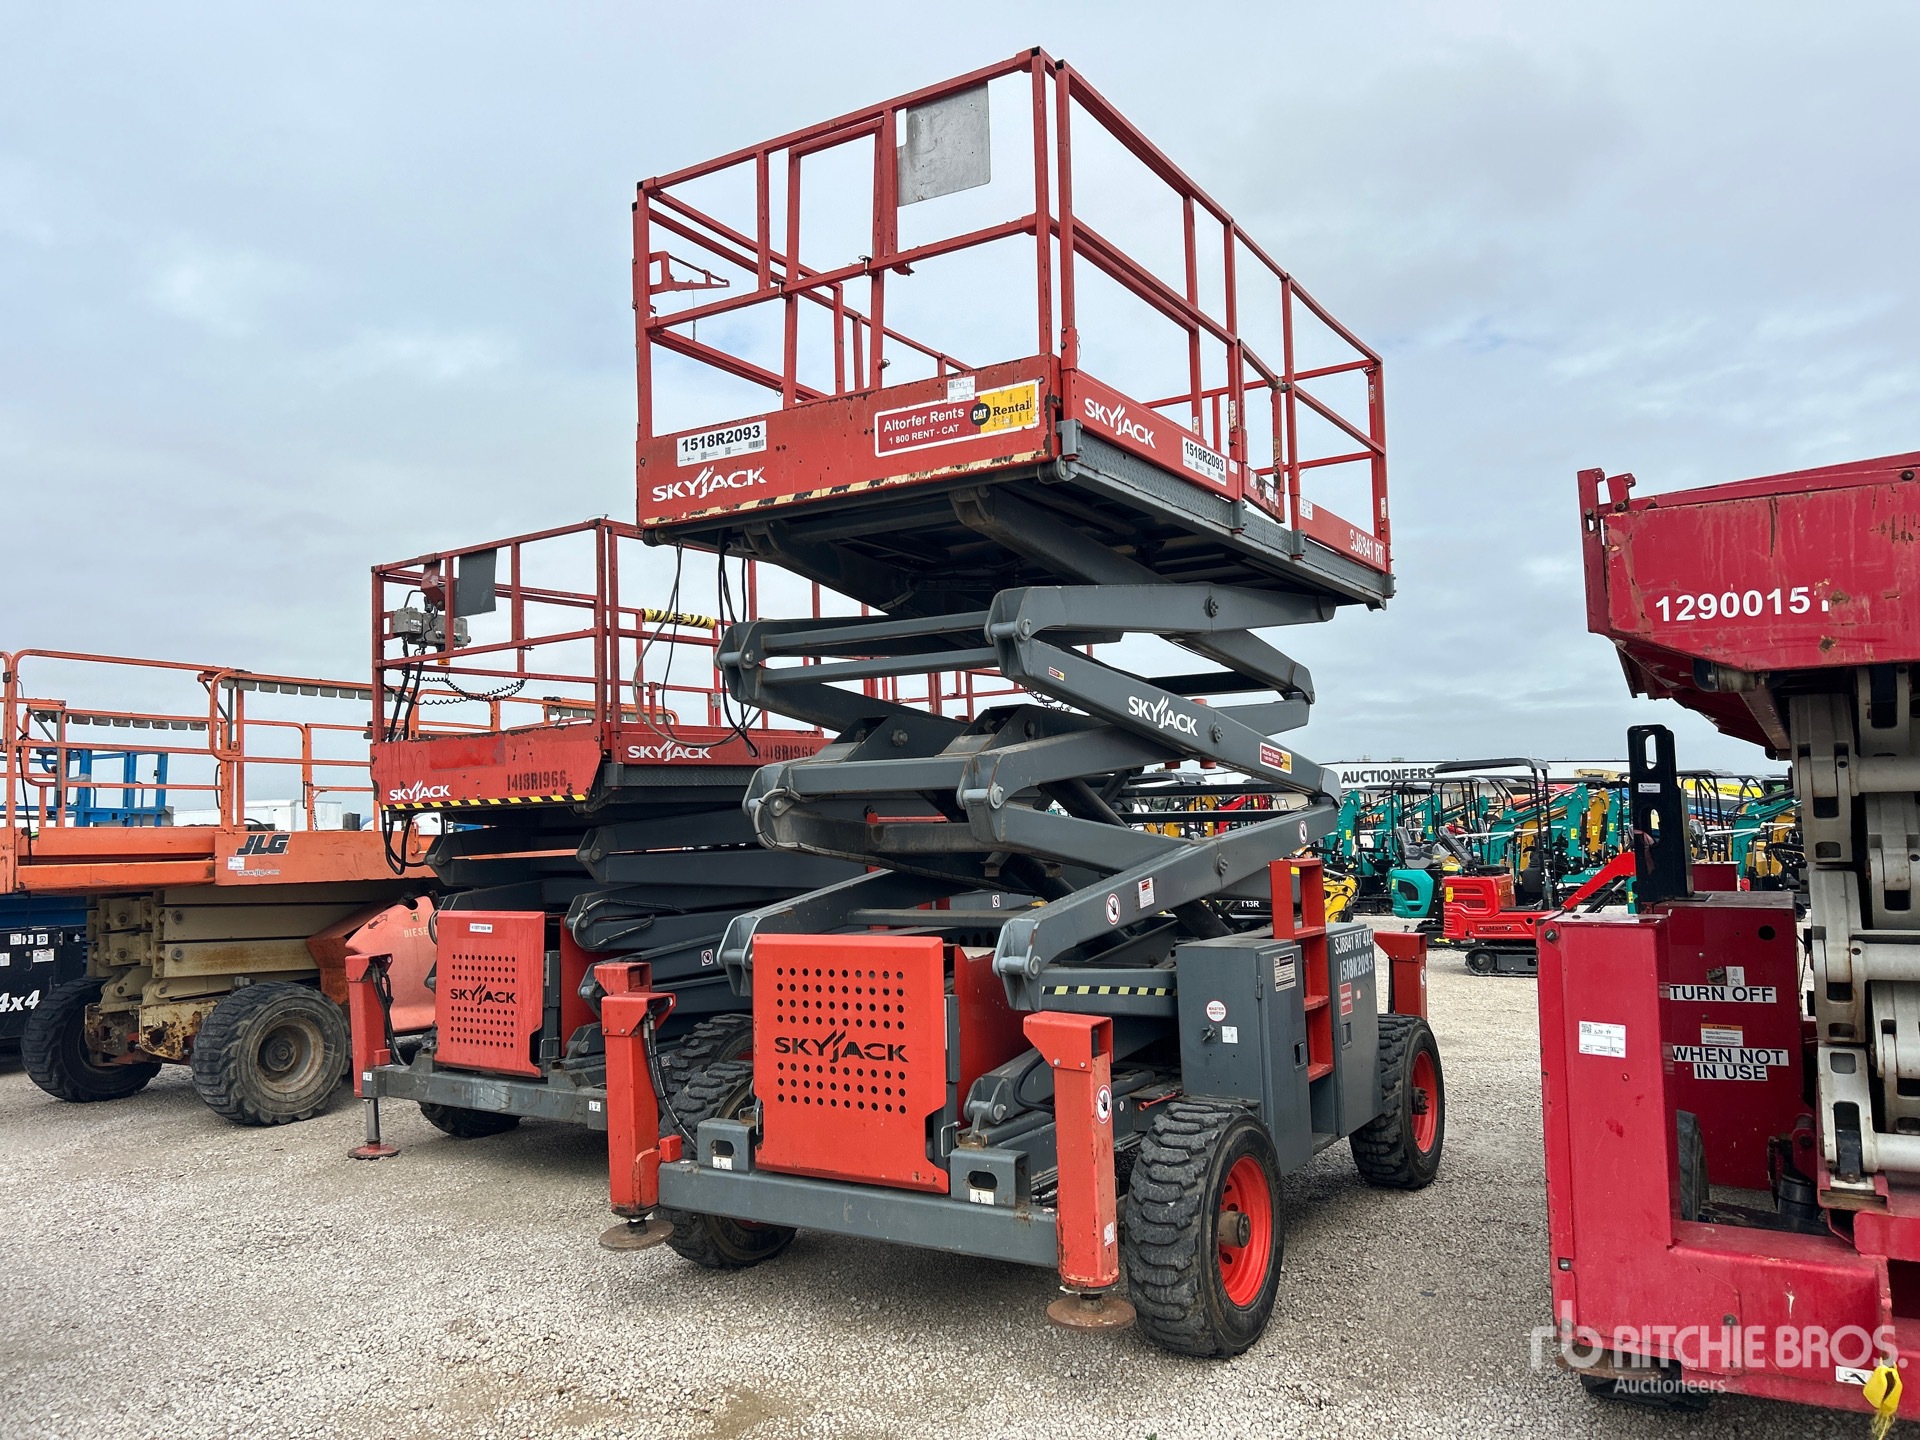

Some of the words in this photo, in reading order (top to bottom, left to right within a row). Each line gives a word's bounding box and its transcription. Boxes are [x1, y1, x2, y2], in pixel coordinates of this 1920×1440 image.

[883, 412, 929, 432] Altorfer
[930, 406, 965, 423] Rents
[972, 408, 988, 421] CAT
[992, 400, 1030, 417] Rental
[895, 434, 910, 445] 800
[911, 428, 934, 442] RENT
[941, 424, 960, 435] CAT
[1084, 397, 1157, 449] SKYJACK
[682, 424, 761, 453] 1518R2093
[1184, 441, 1224, 473] 1518R2093
[652, 465, 767, 502] SKYJACK
[1374, 542, 1384, 565] RT
[1128, 695, 1199, 737] SKYJACK
[627, 740, 712, 762] SKYJACK
[389, 780, 451, 802] SKYJACK
[235, 830, 292, 856] JLG
[403, 926, 430, 938] DIESE
[1334, 934, 1355, 955] SJ8841
[1354, 931, 1362, 950] RT
[0, 989, 41, 1013] 4x4
[449, 983, 517, 1006] SKYJACK
[1669, 985, 1726, 1001] TURN
[1732, 986, 1774, 1002] OFF
[774, 1029, 910, 1064] SKYJACK
[1672, 1046, 1733, 1063] WHEN
[1739, 1048, 1784, 1065] NOT
[1696, 1064, 1718, 1079] IN
[1724, 1064, 1767, 1080] USE
